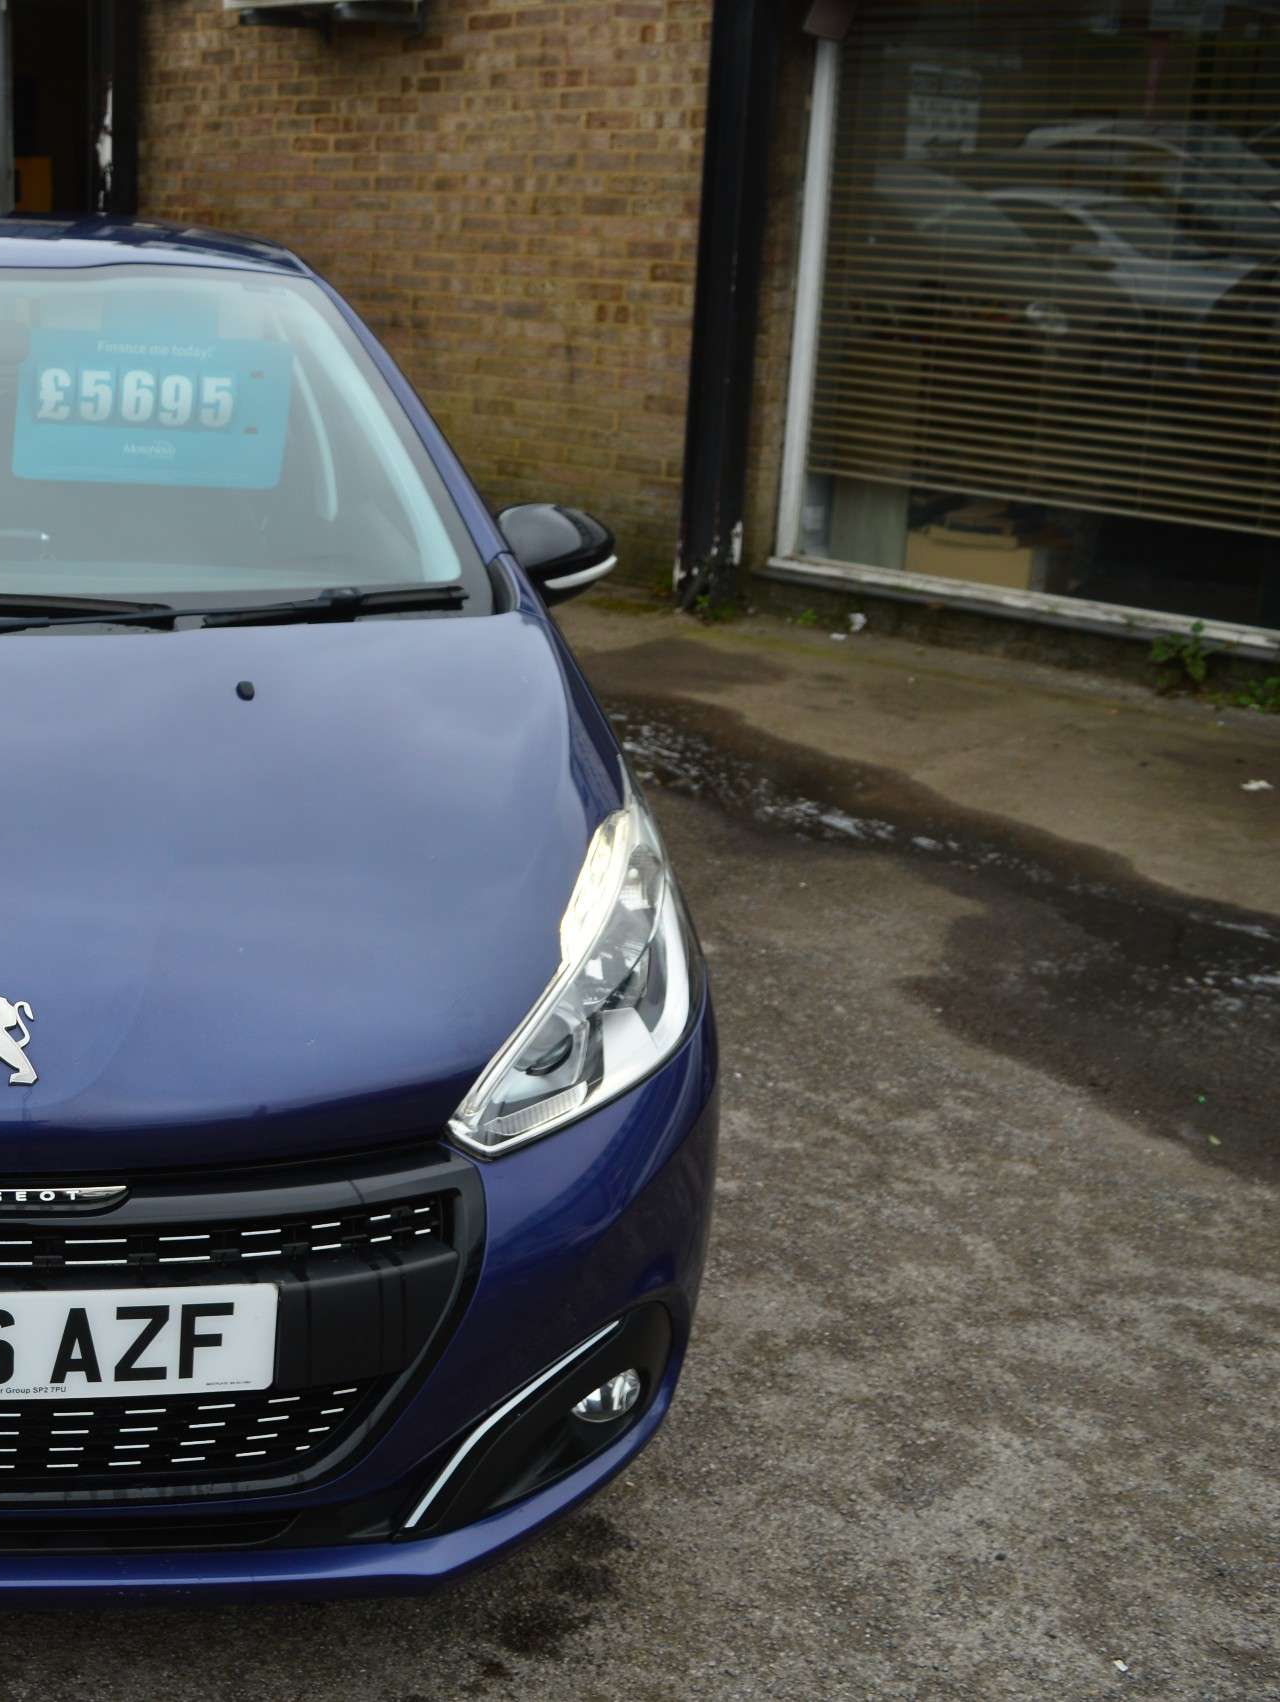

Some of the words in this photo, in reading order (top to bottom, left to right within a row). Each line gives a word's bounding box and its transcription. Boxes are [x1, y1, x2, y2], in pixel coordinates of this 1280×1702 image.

[37, 367, 234, 428] £5695
[49, 1302, 234, 1384] AZF
[5, 1387, 31, 1395] Group
[33, 1386, 48, 1394] SP2
